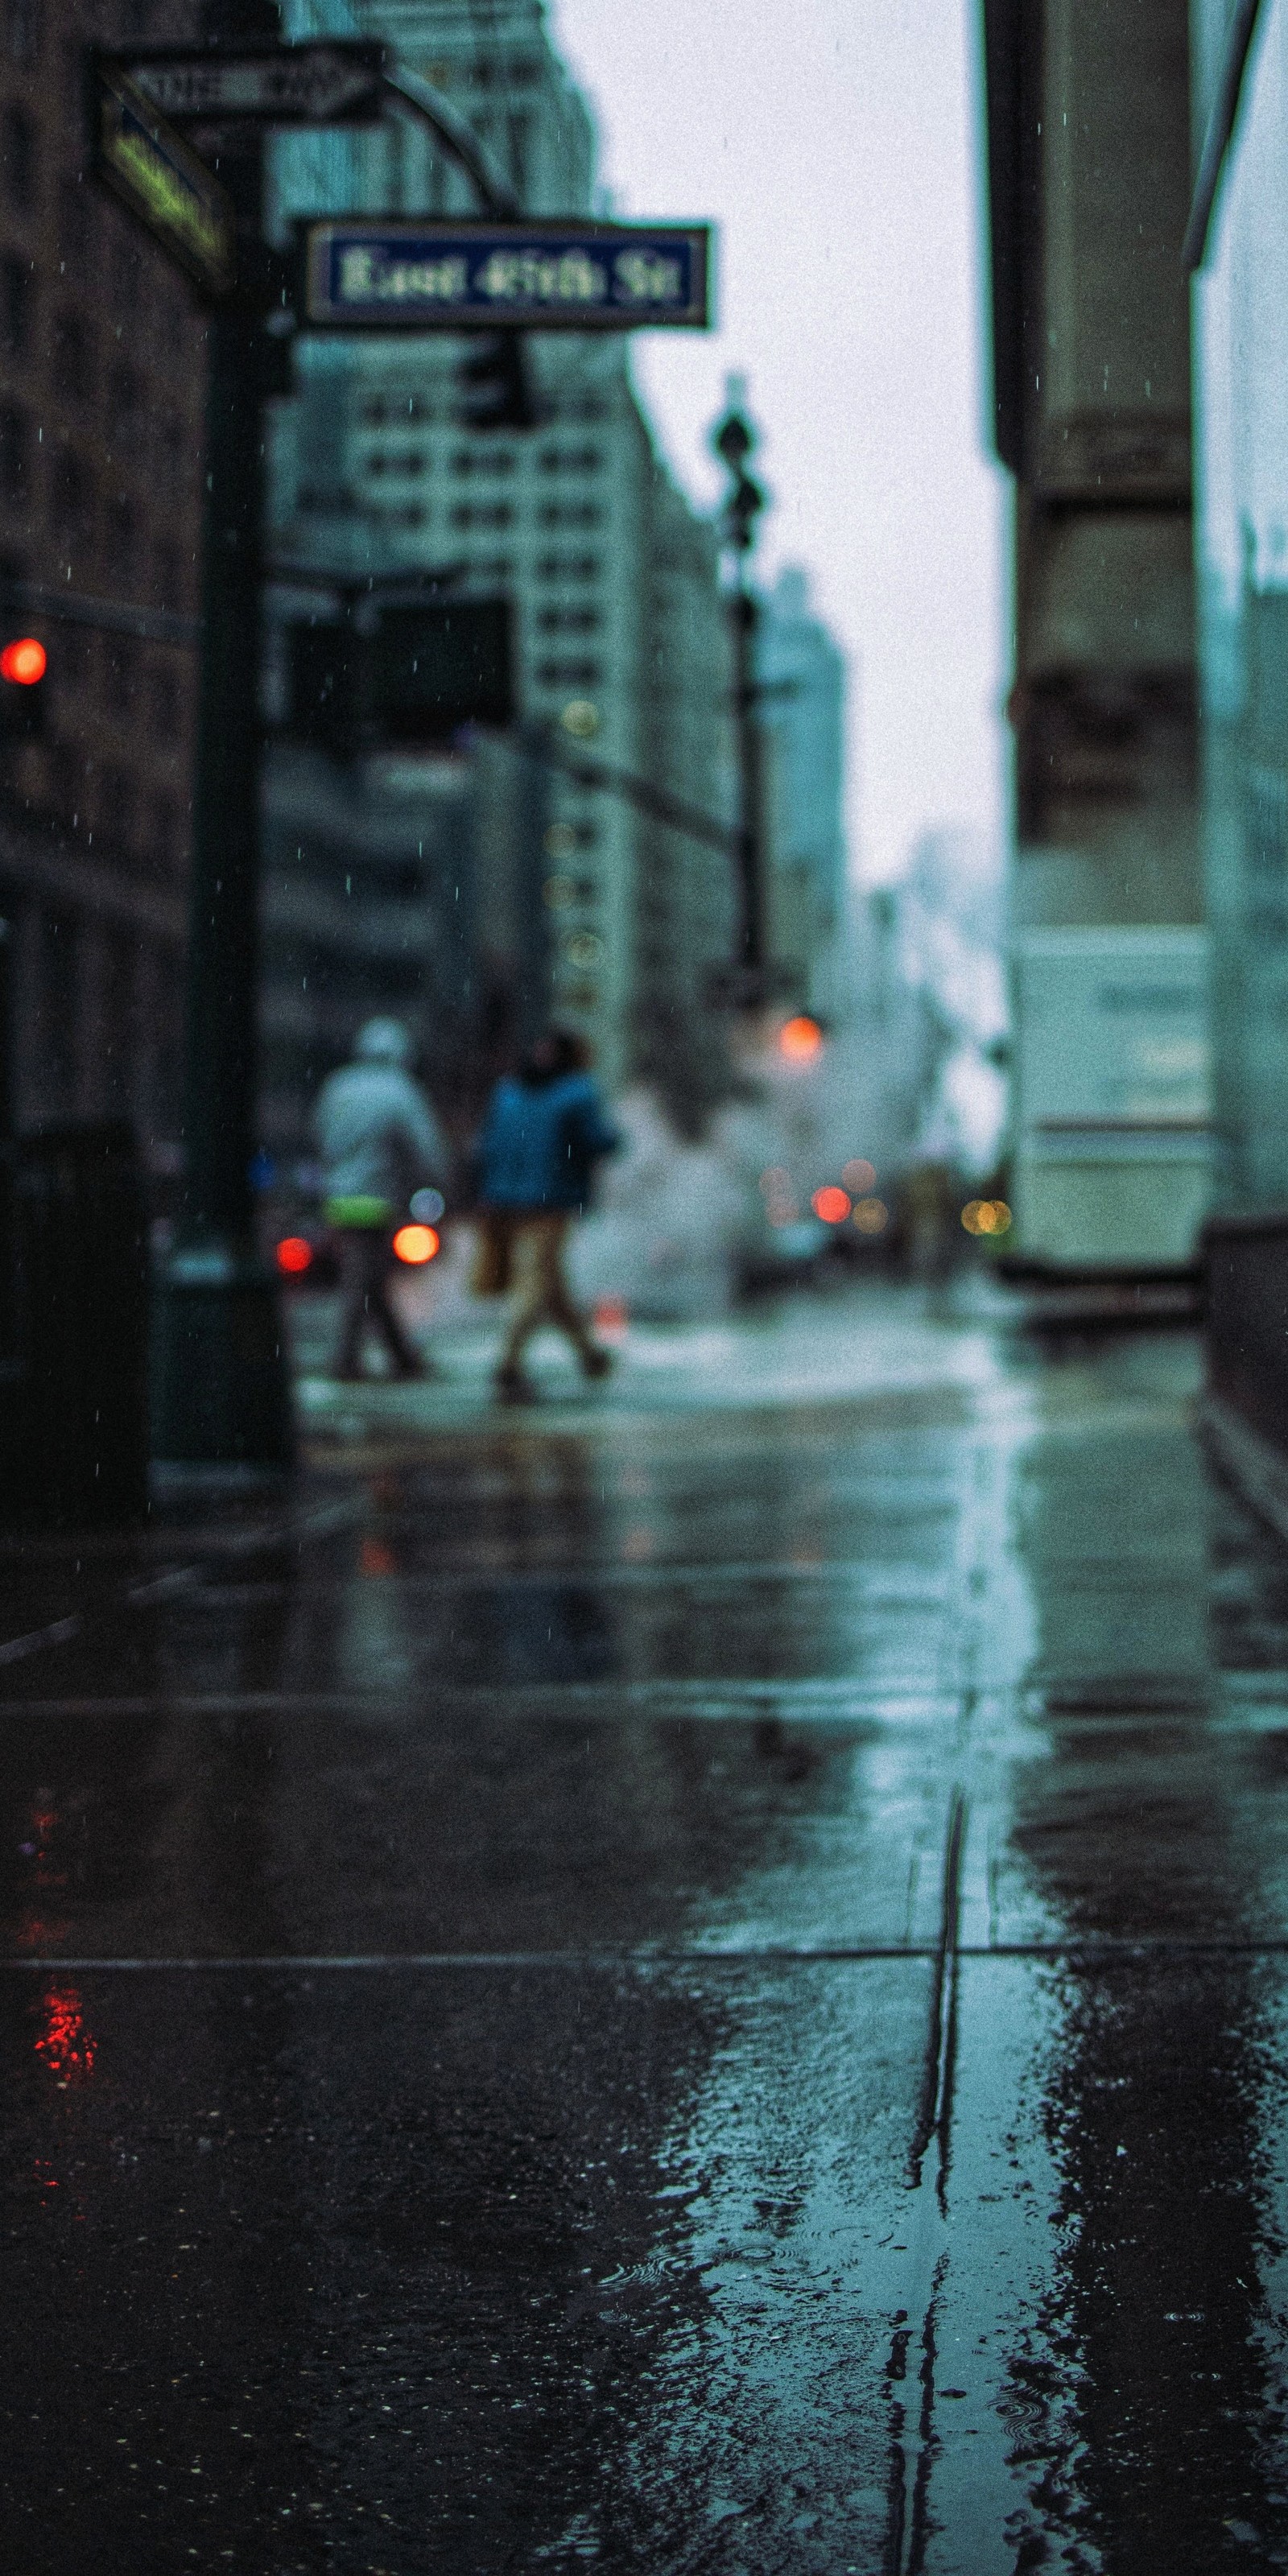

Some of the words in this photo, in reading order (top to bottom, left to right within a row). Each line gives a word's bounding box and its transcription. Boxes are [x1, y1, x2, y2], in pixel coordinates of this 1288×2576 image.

[340, 246, 467, 303] East
[473, 247, 607, 303] 45th
[613, 247, 681, 305] St
